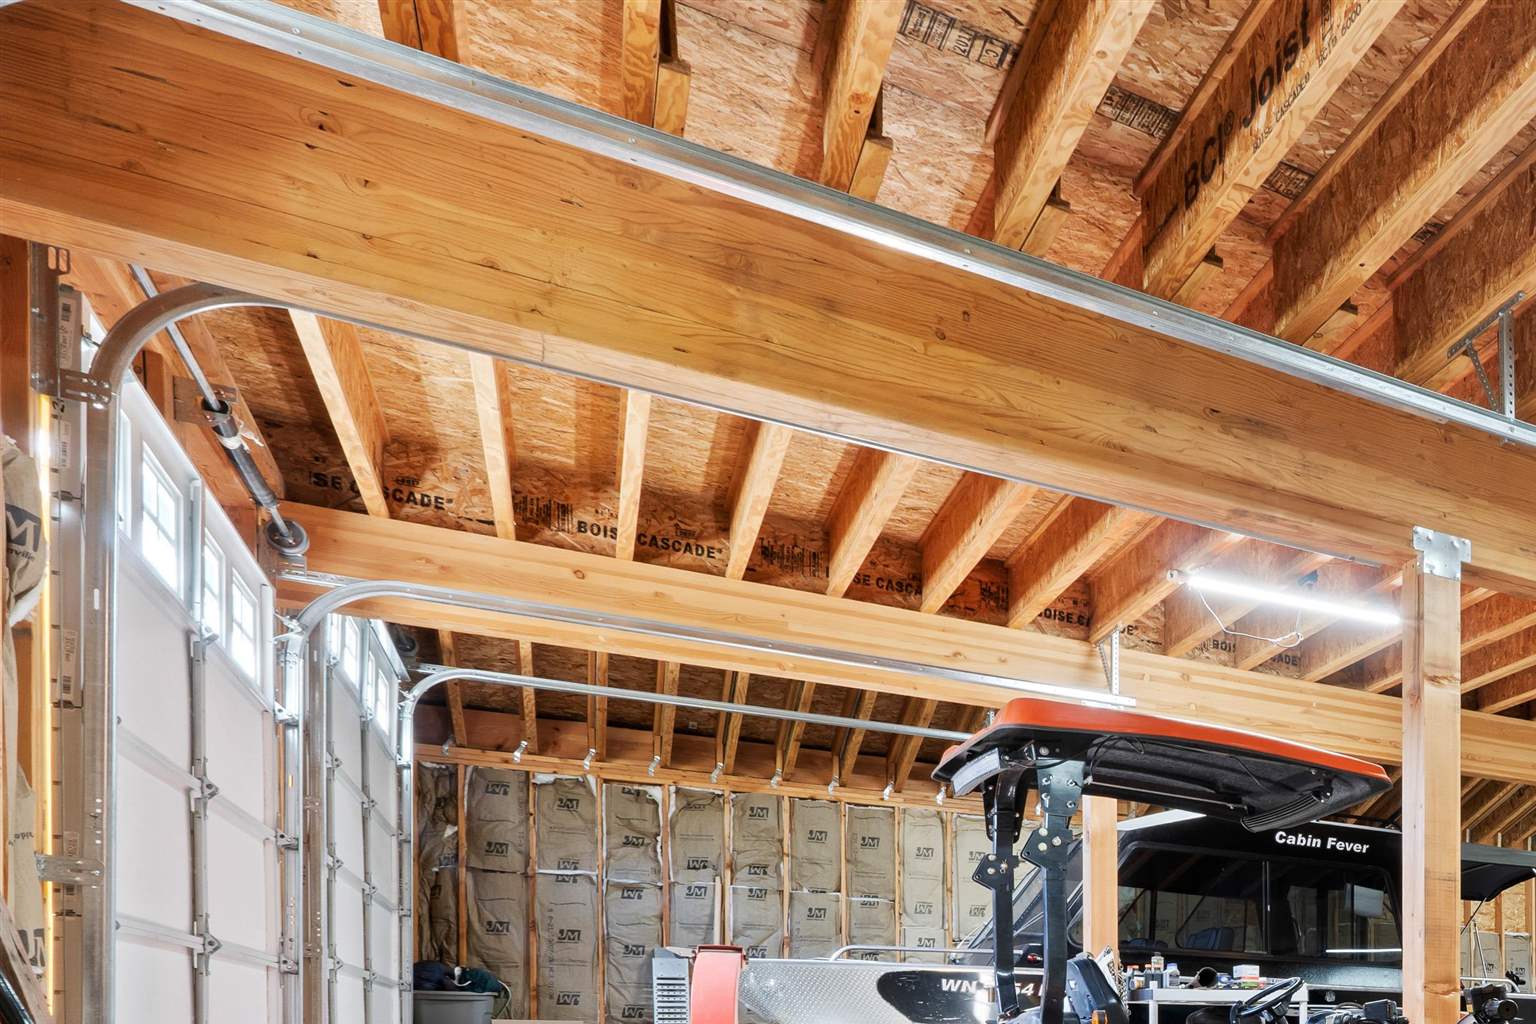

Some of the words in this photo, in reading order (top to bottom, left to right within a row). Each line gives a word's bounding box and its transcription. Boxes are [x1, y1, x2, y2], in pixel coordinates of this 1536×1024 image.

[577, 519, 617, 540] BOIS
[876, 577, 921, 595] CASCA
[1275, 831, 1321, 849] Cabin
[1326, 837, 1370, 853] Fever
[941, 978, 977, 994] WN
